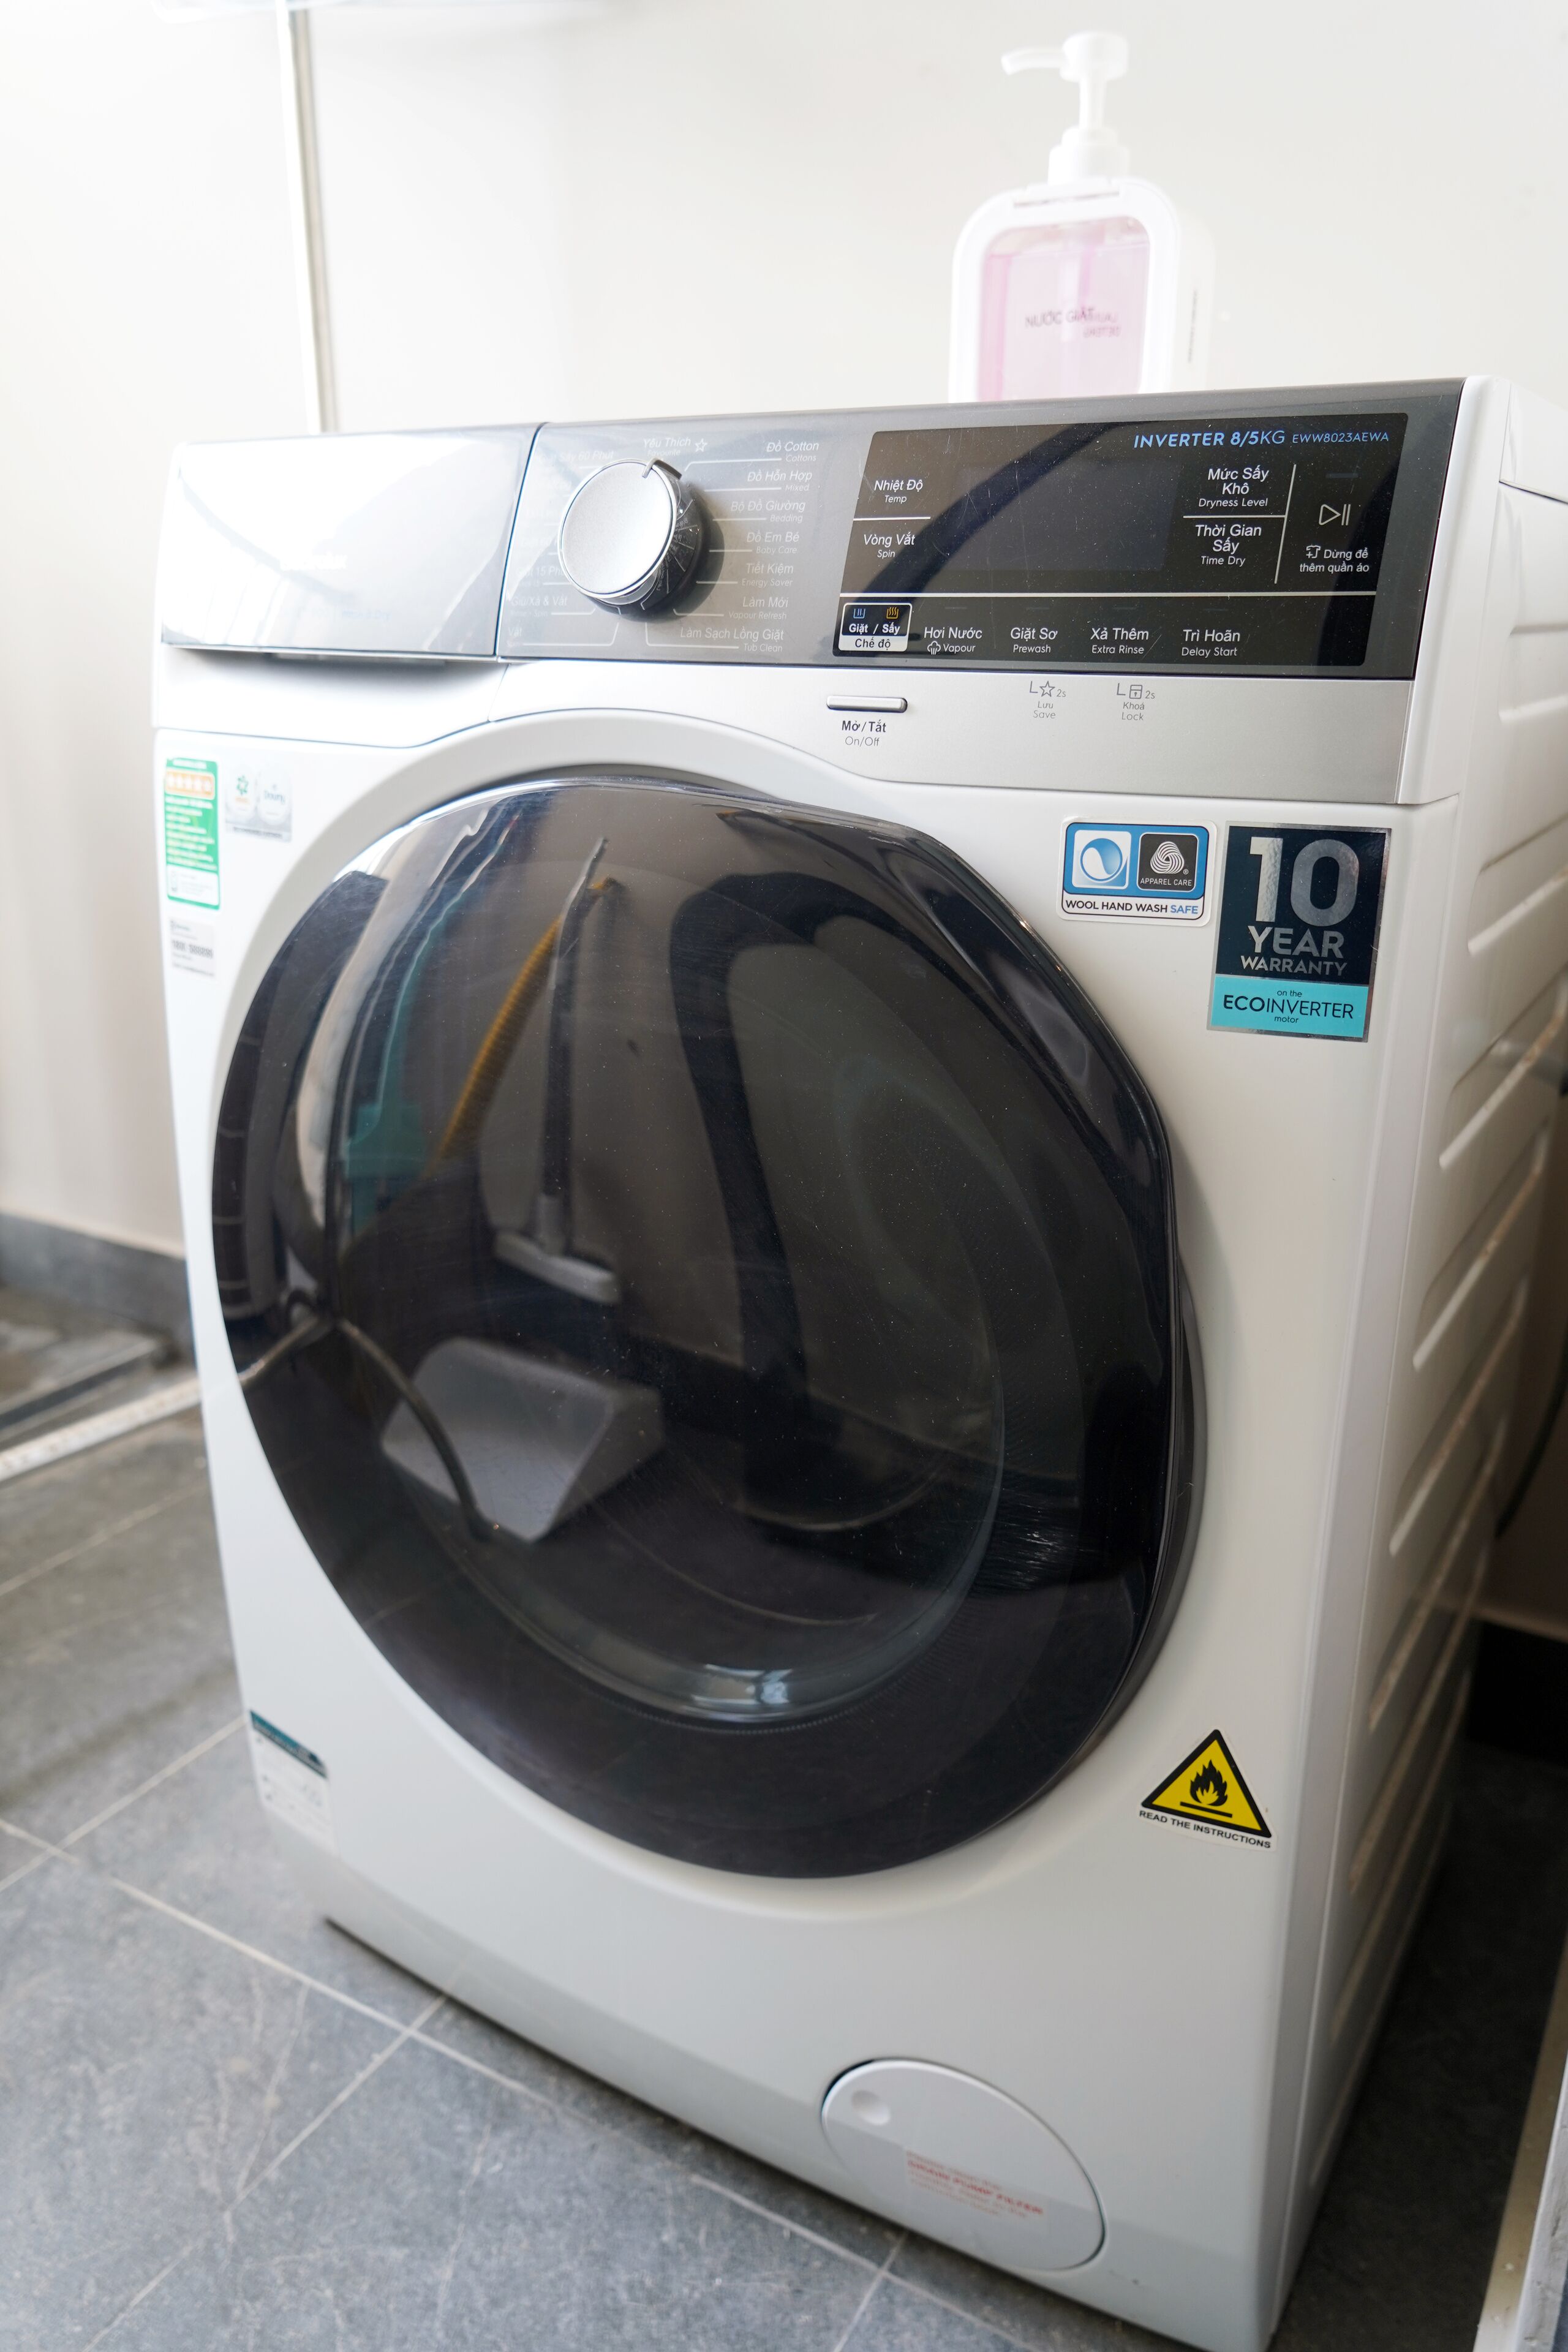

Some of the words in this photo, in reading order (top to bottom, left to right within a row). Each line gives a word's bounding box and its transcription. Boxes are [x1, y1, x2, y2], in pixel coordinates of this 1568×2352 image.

[644, 439, 662, 449] Yêu
[665, 437, 691, 448] Thích
[1133, 432, 1224, 448] INVERTER
[1230, 430, 1285, 447] 8/5KG
[1292, 432, 1389, 444] EWW8023AEWA
[766, 441, 782, 453] Đồ
[785, 441, 819, 452] Cotton
[786, 454, 816, 462] Cottons
[747, 470, 764, 482] Đồ
[766, 470, 786, 481] Hỗn
[788, 470, 812, 483] Hợp
[1208, 467, 1238, 481] Mức
[1242, 466, 1268, 482] Sấy
[874, 480, 904, 491] Nhiệt
[907, 480, 923, 491] Độ
[1222, 482, 1250, 495] Khô
[884, 495, 907, 503] Temp
[1199, 499, 1238, 508] Dryness
[1242, 498, 1268, 507] Level
[731, 500, 745, 512] Bộ
[747, 500, 763, 512] Đồ
[765, 500, 805, 513] Giường
[771, 514, 803, 524] Bedding
[1196, 524, 1226, 537] Thời
[1229, 524, 1262, 537] Gian
[747, 532, 763, 543] Đồ
[765, 532, 782, 542] Em
[785, 532, 799, 542] Bé
[864, 533, 892, 548] Vòng
[895, 532, 915, 546] Vắt
[756, 546, 775, 555] Baby
[1213, 537, 1239, 554] Sấy
[876, 549, 895, 558] Spin
[1324, 549, 1352, 561] Dừng
[1355, 547, 1368, 559] để
[1201, 556, 1224, 565] Time
[1227, 556, 1246, 567] Dry
[747, 562, 766, 573] Tiết
[769, 563, 793, 575] Kiệm
[1299, 562, 1324, 572] thêm
[1327, 562, 1354, 576] quần
[1356, 563, 1370, 572] áo
[742, 578, 769, 588] Energy
[743, 597, 763, 607] Làm
[766, 596, 789, 608] Mới
[849, 623, 869, 635] Giặt
[882, 622, 900, 635] Sấy
[924, 627, 945, 639] Hơi
[948, 626, 982, 639] Nước
[1010, 627, 1036, 641] Giặt
[1038, 627, 1058, 640] Sơ
[1091, 628, 1107, 640] Xả
[1112, 628, 1149, 640] Thêm
[680, 628, 702, 639] Làm
[705, 628, 731, 639] Sạch
[733, 628, 760, 642] Lồng
[762, 628, 784, 641] Giặt
[1183, 629, 1200, 641] Trì
[1204, 630, 1240, 642] Hoãn
[854, 637, 875, 649] Chế
[878, 638, 891, 649] độ
[943, 643, 976, 654] Vapour
[1013, 644, 1051, 654] Prewash
[1092, 645, 1115, 654] Extra
[1118, 646, 1144, 654] Rinse
[1182, 647, 1210, 658] Delay
[1213, 647, 1237, 657] Start
[1057, 688, 1066, 698] 2s
[1038, 701, 1054, 709] Lưu
[1123, 702, 1145, 710] Khoá
[1033, 710, 1056, 719] Save
[1121, 712, 1144, 721] Lock
[845, 736, 880, 747] On/Off
[1140, 876, 1170, 886] APPAREL
[1174, 878, 1192, 888] CARE
[1249, 836, 1360, 927] 10
[1065, 900, 1100, 911] WOOL
[1101, 902, 1133, 912] HAND
[1136, 903, 1168, 913] WASH
[1170, 904, 1199, 914] SAFE
[1248, 925, 1345, 959] YEAR
[1240, 955, 1348, 976] WARRANTY
[1223, 994, 1354, 1020] ECOINVERTER
[1139, 1810, 1167, 1823] READ
[1171, 1818, 1191, 1829] THE
[1194, 1824, 1271, 1849] INSTRUCTIONS
